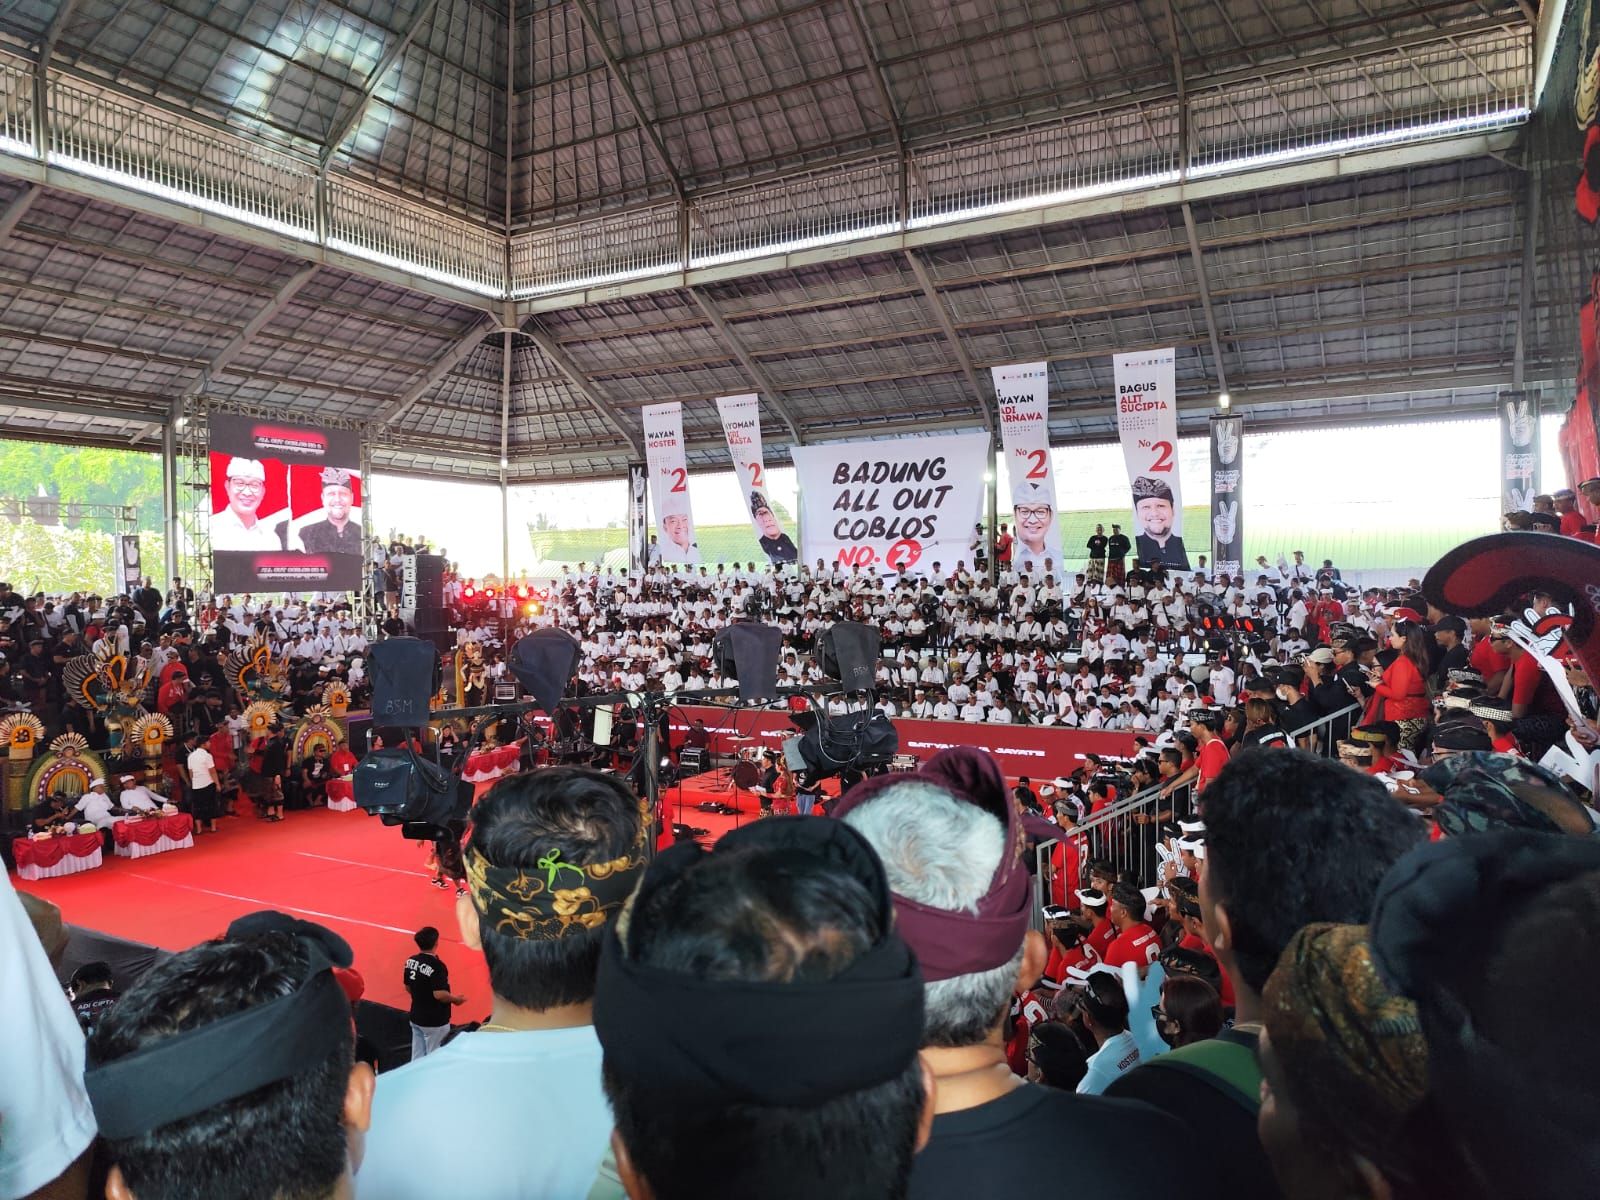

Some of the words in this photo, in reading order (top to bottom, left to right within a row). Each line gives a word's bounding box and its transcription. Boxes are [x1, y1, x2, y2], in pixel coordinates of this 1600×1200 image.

[1120, 382, 1157, 394] BAGUS
[999, 394, 1034, 405] WAYAN
[1120, 394, 1143, 404] ALIT
[1121, 401, 1168, 413] SUCIPTA
[647, 430, 675, 439] WAYAN
[648, 439, 677, 448] KOSTER
[1025, 449, 1048, 479] 2
[1149, 440, 1174, 473] 2
[670, 467, 687, 493] 2
[748, 463, 763, 487] 2
[832, 457, 947, 485] BADUNG
[833, 488, 880, 512] ALL
[893, 485, 954, 511] OUT
[833, 514, 938, 541] COBLOS
[409, 970, 417, 980] 2
